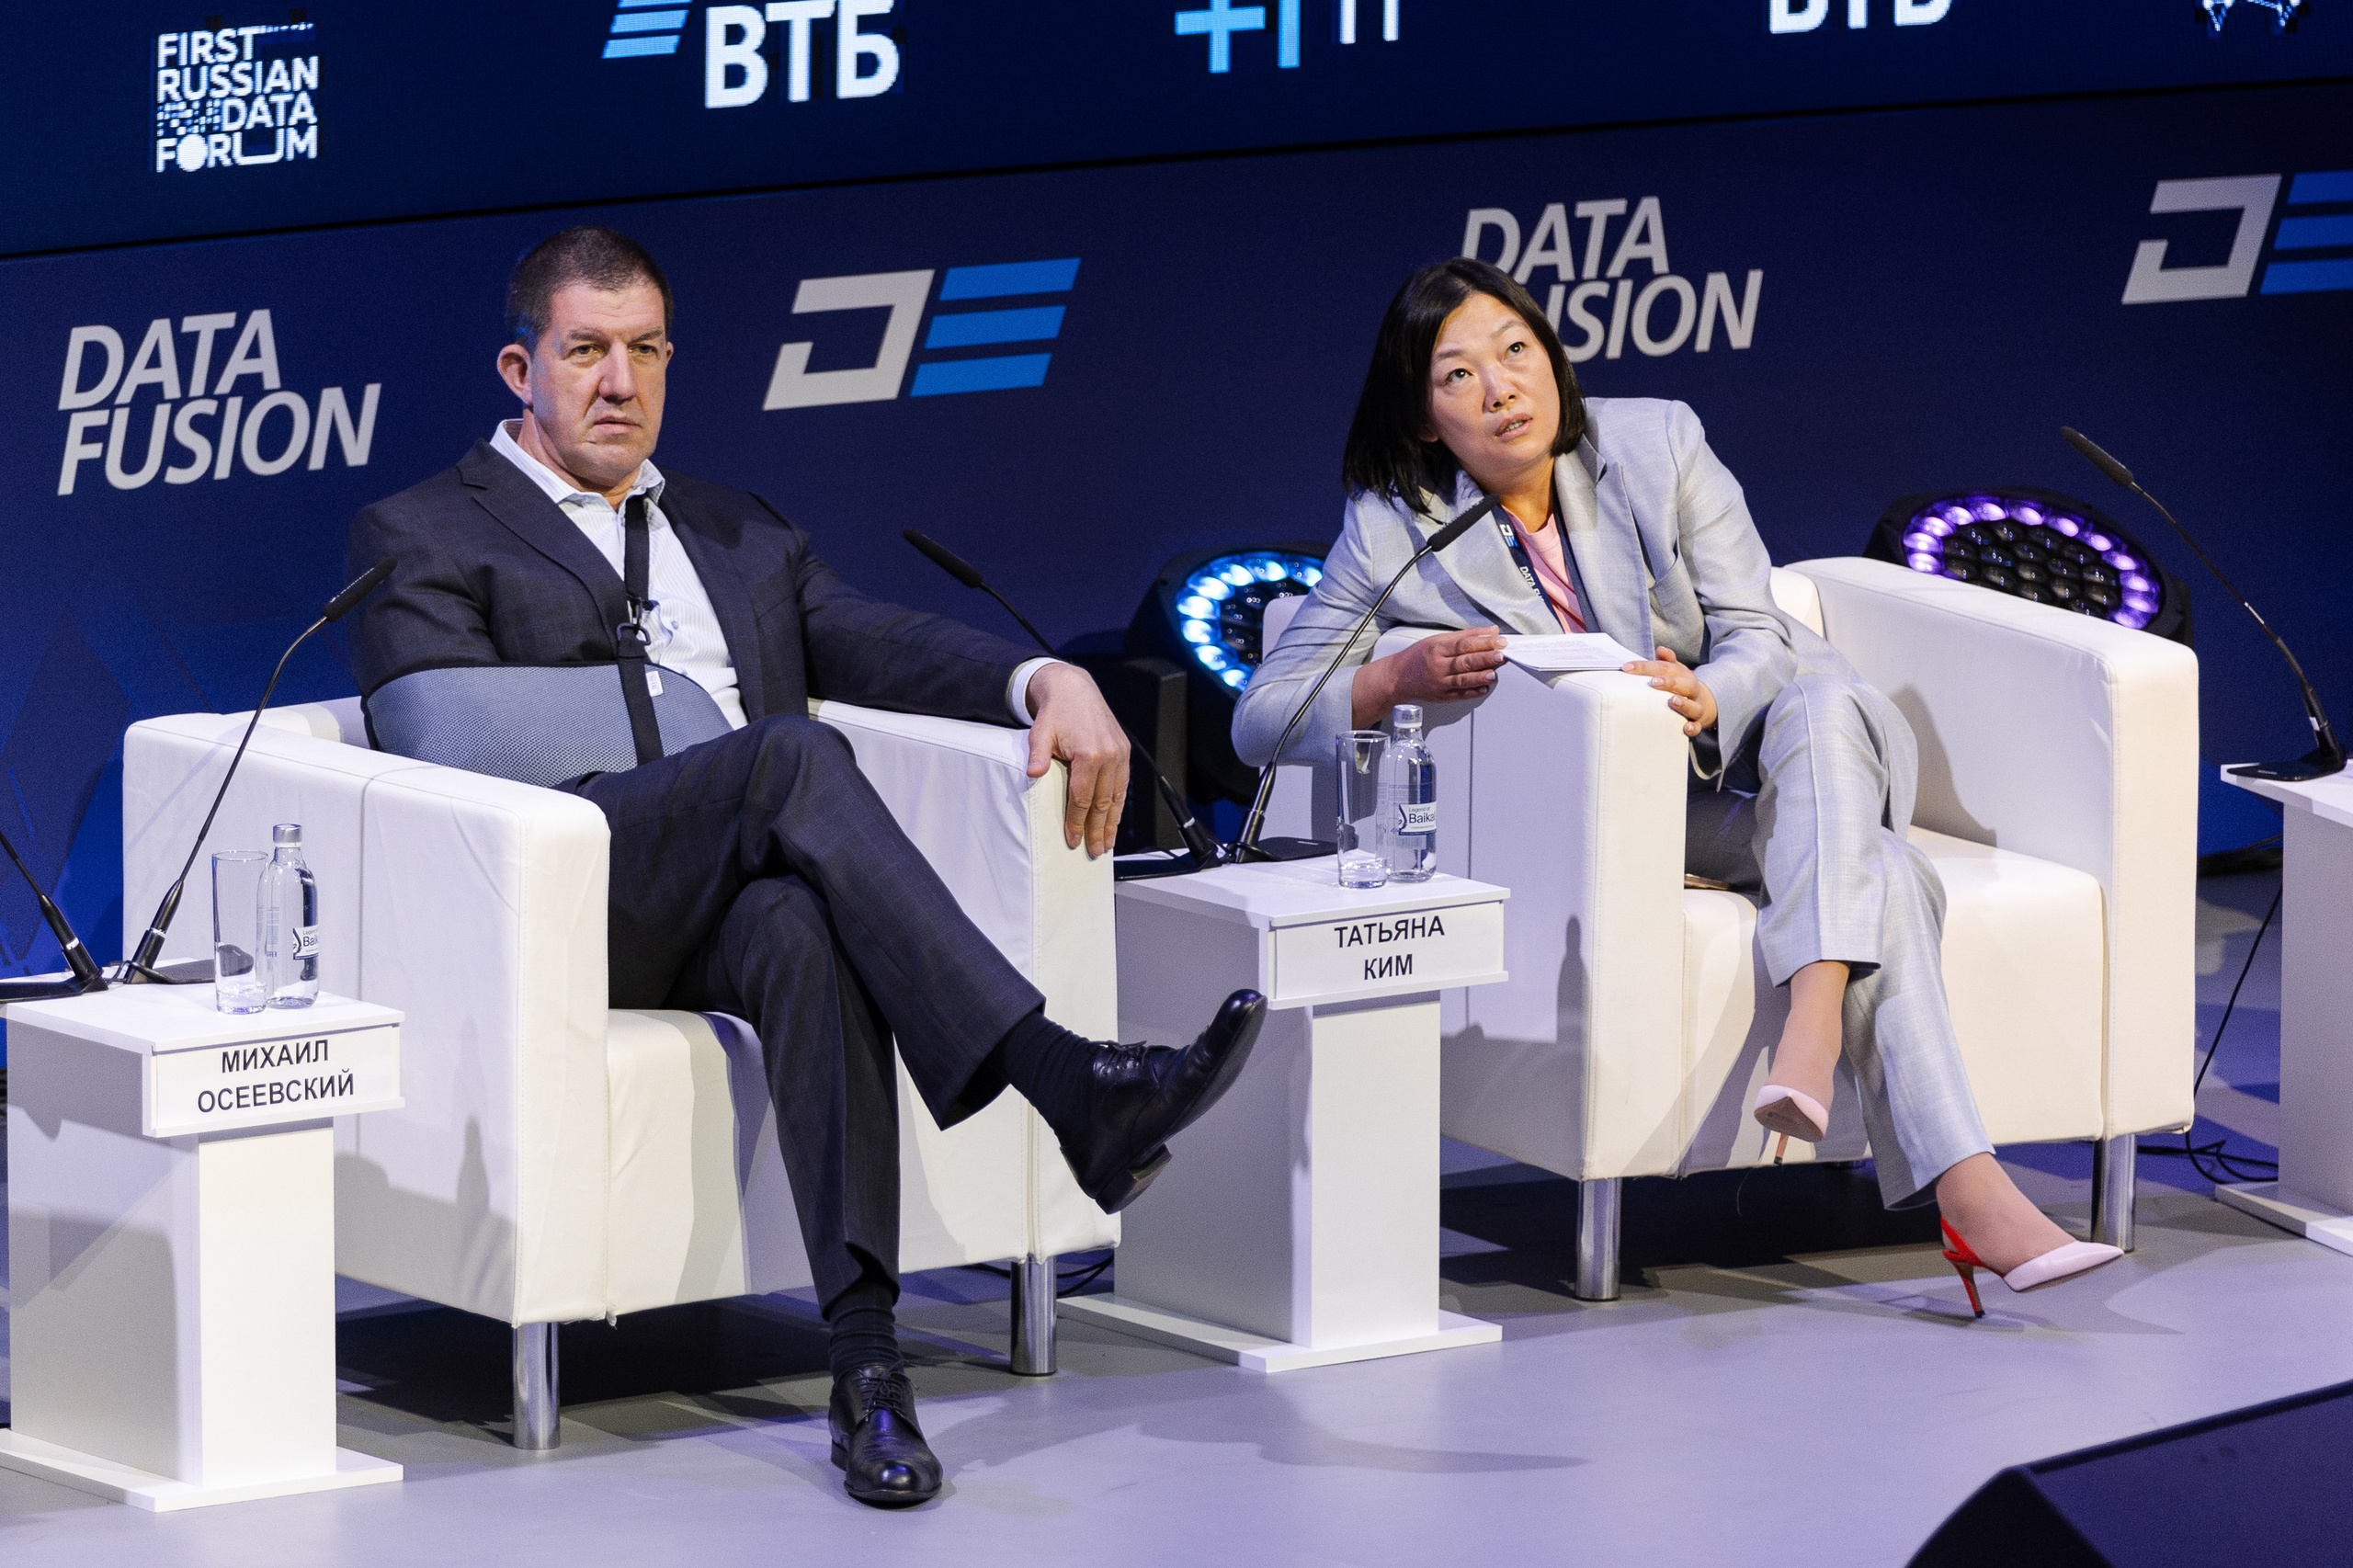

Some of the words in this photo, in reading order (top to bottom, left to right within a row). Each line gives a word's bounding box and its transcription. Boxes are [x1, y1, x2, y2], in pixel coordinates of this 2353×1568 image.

[157, 27, 267, 68] FIRST
[704, 0, 901, 109] ВТБ
[156, 55, 319, 104] RUSSIAN
[221, 91, 318, 131] DATA
[156, 125, 318, 173] FORUM
[1461, 196, 1670, 285] DATA
[1546, 268, 1764, 363] SION
[58, 309, 281, 411] DATA
[57, 382, 381, 496] FUSION
[1334, 915, 1445, 949] ТАТЬЯНА
[1364, 953, 1413, 981] КИМ
[222, 1039, 329, 1074] МИХАИЛ
[197, 1068, 355, 1113] ОСЕЕВСКИЙ
